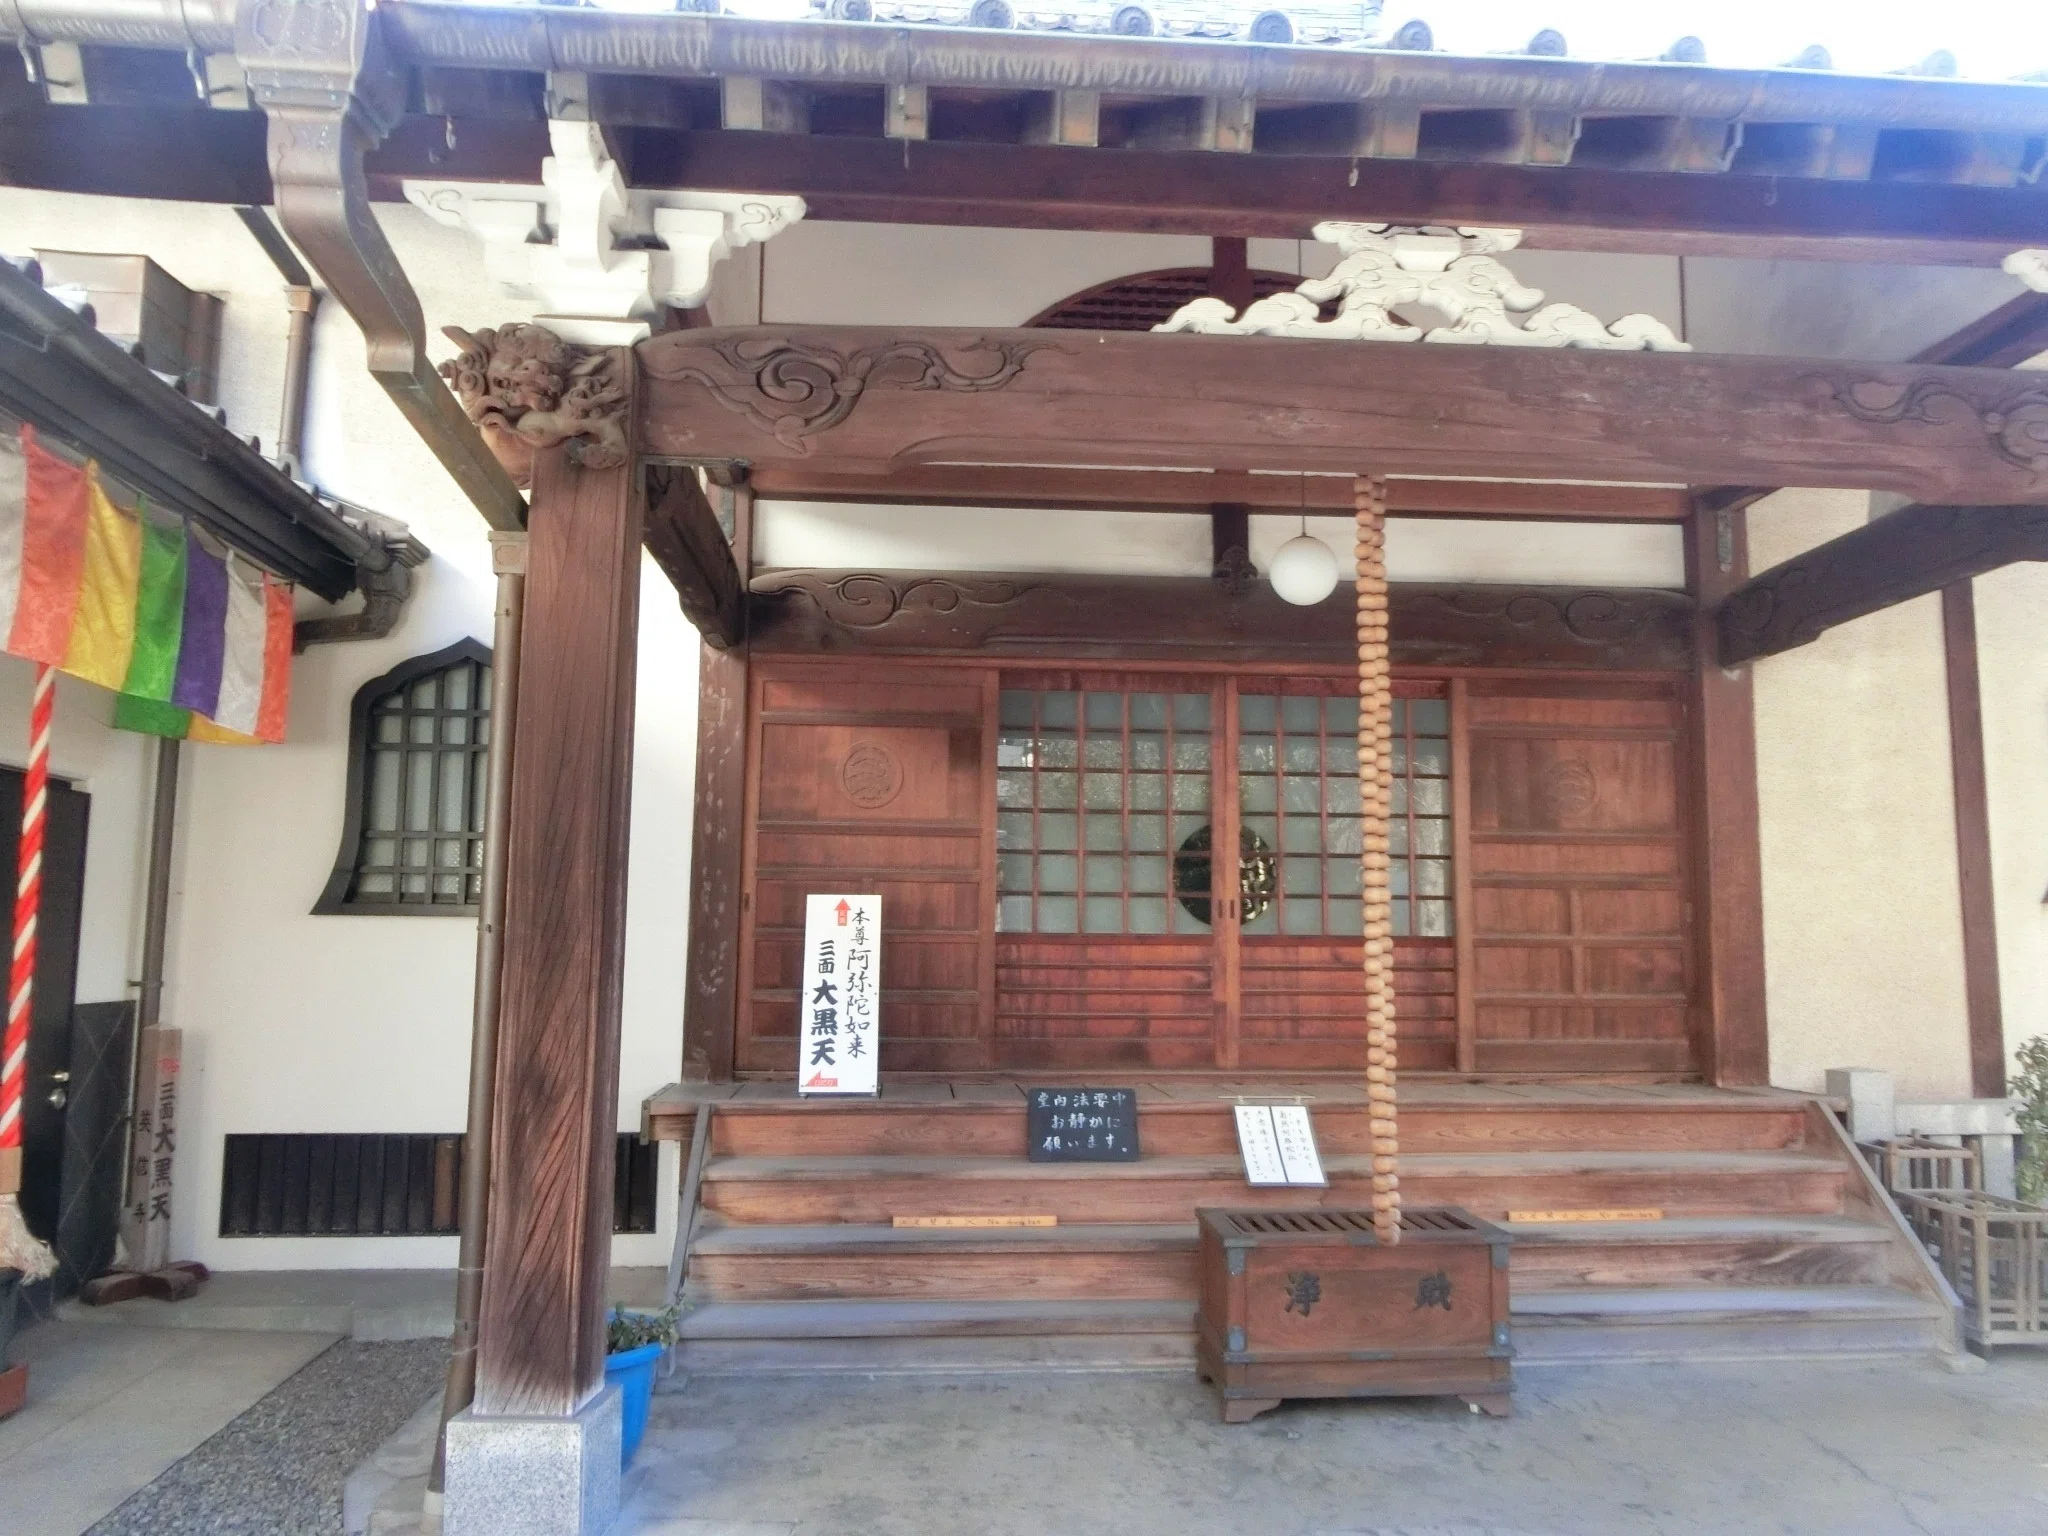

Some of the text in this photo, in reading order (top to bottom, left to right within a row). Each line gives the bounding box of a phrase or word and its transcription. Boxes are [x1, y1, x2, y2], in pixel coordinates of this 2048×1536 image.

[811, 940, 838, 1066] 三面大黒天
[844, 907, 871, 1059] 本尊阿弥陀如来
[1037, 1091, 1126, 1109] 堂内法要中
[1051, 1112, 1121, 1129] お静かに
[150, 1083, 175, 1221] 三面大黒天
[1042, 1133, 1128, 1153] 願います。
